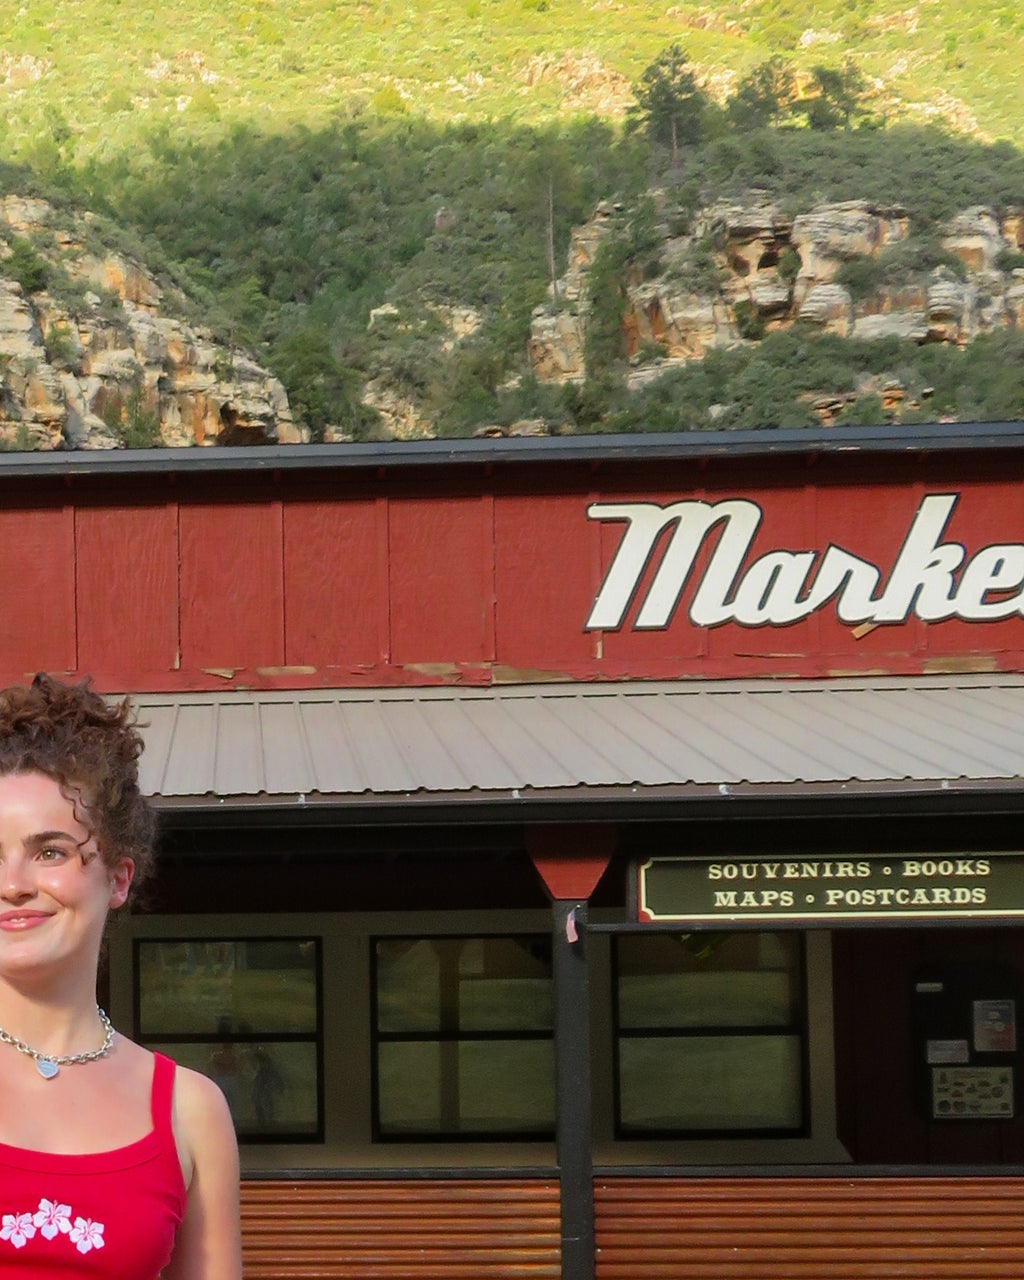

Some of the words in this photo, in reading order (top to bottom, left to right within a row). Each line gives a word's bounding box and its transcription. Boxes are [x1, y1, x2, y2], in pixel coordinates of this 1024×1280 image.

[584, 493, 1024, 631] Marke
[709, 862, 872, 879] SOUVENIRS
[902, 860, 991, 877] BOOKS
[714, 891, 795, 908] MAPS
[826, 887, 987, 906] POSTCARDS
